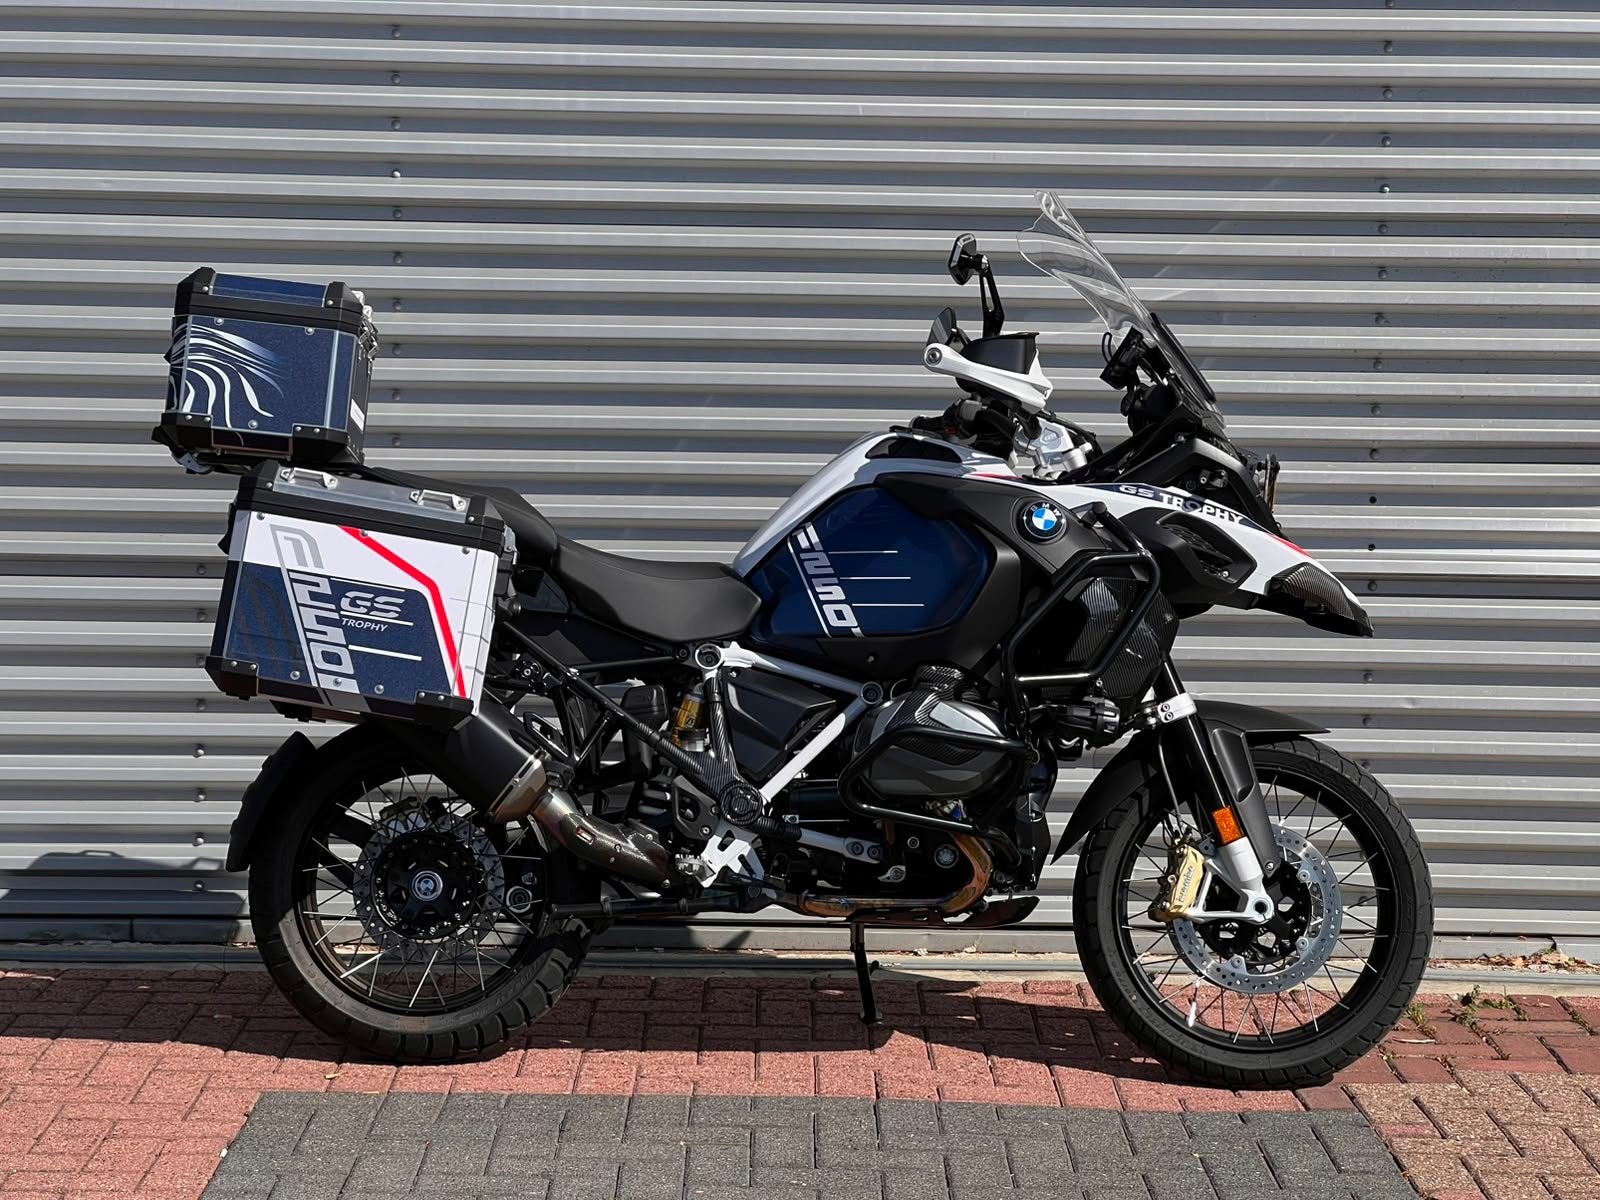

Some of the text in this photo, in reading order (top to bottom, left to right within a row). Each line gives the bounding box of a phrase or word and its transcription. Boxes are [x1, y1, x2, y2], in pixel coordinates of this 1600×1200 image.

[1030, 502, 1062, 517] BMW
[1119, 485, 1243, 524] GS TROPHY
[340, 591, 405, 618] GS
[341, 617, 389, 632] TROPHY
